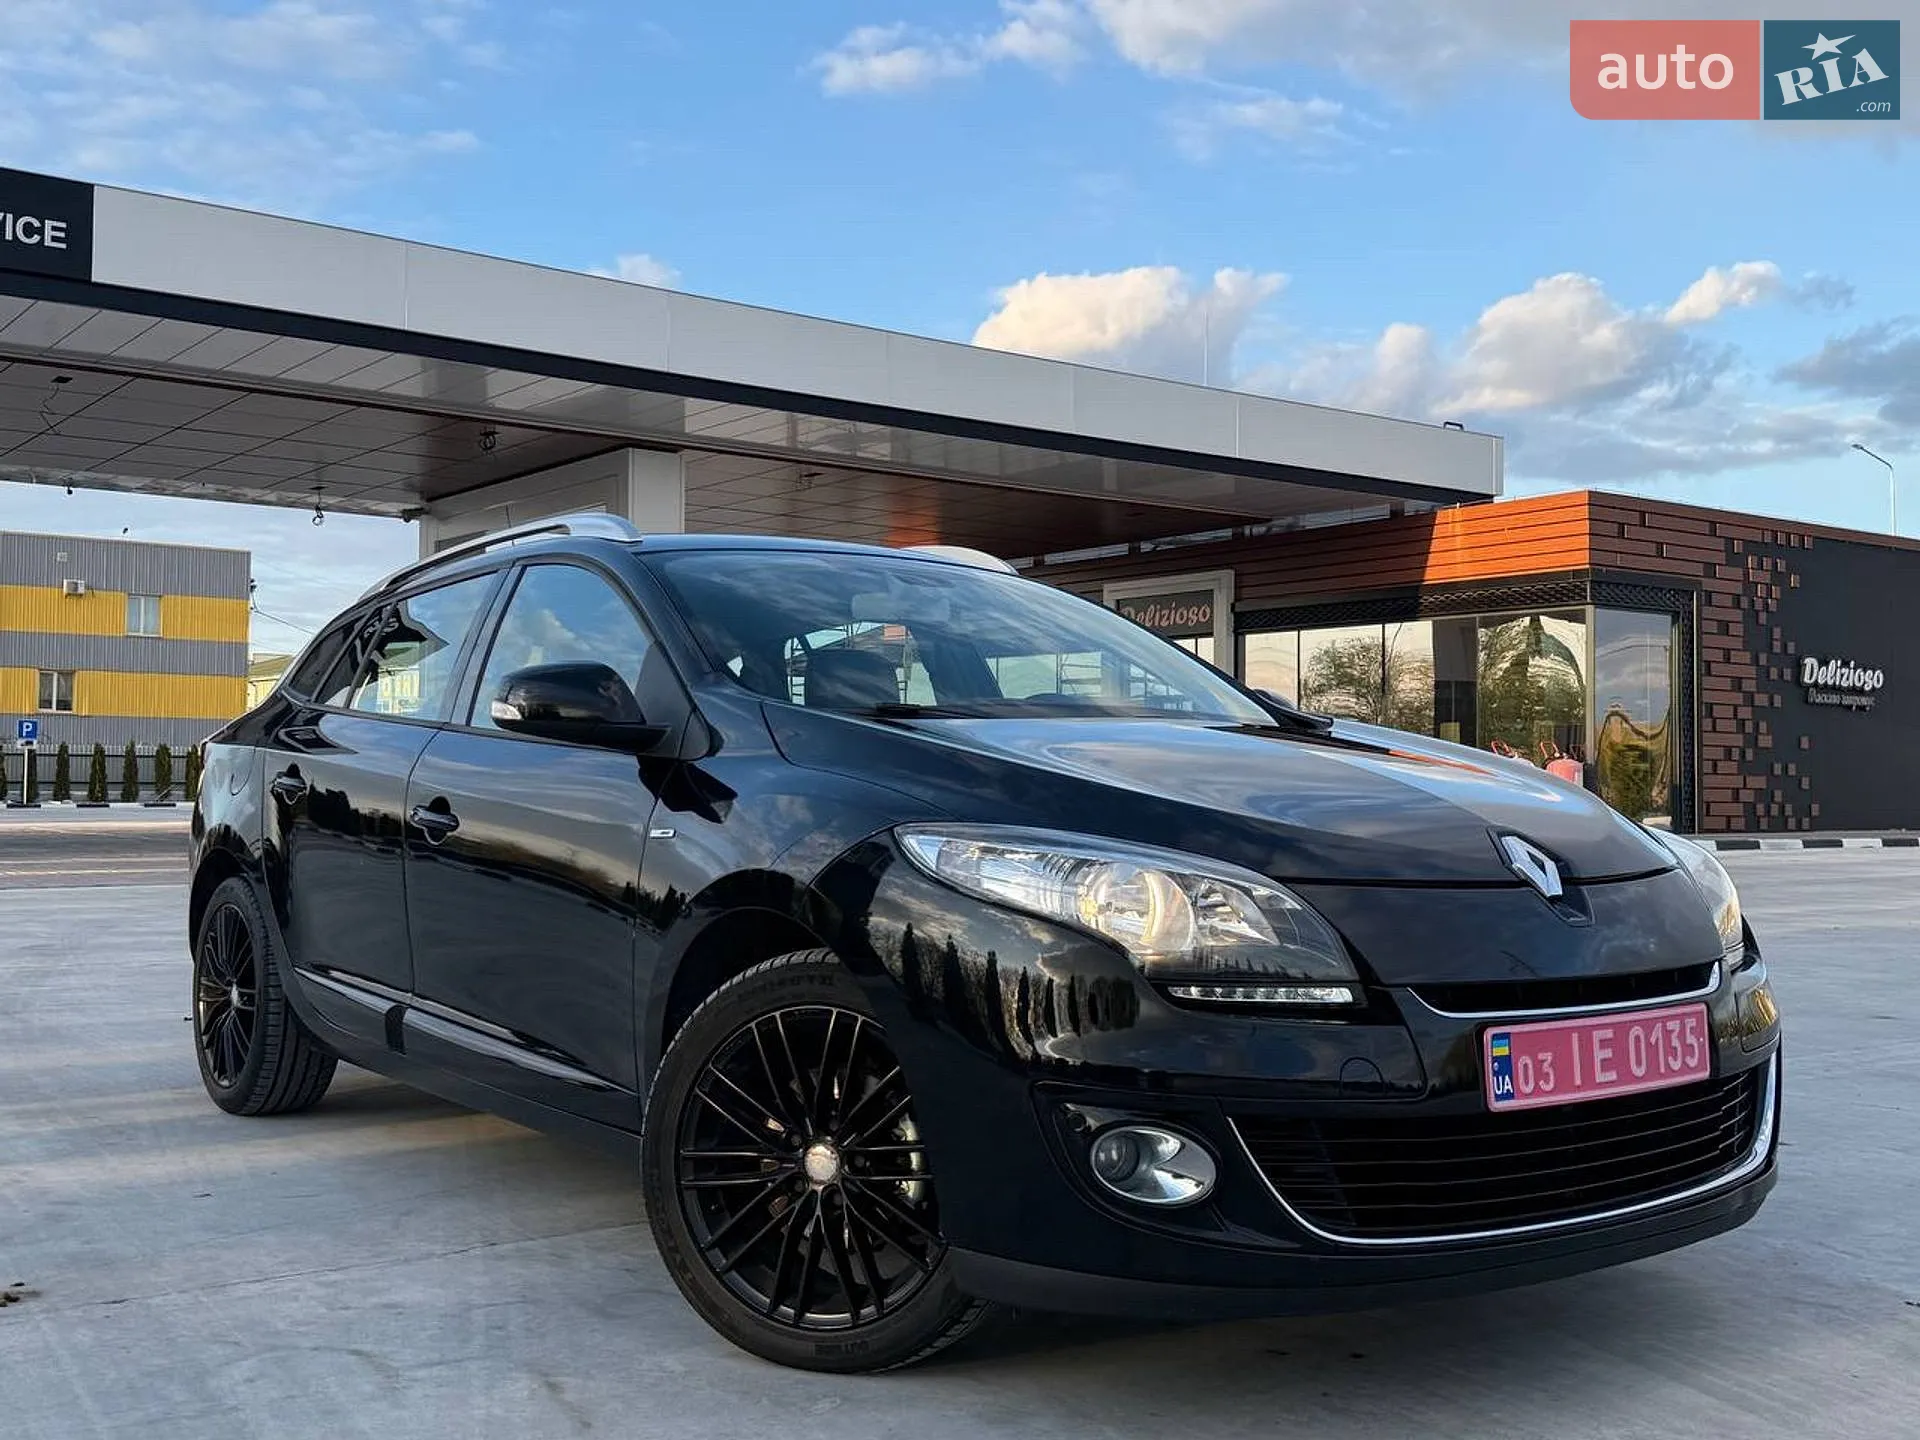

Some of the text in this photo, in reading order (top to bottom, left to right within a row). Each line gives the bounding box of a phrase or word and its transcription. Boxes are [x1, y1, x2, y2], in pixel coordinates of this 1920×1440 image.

[22, 721, 33, 737] P
[1517, 1017, 1700, 1095] 03 IE 0135
[1492, 1075, 1514, 1095] UA
